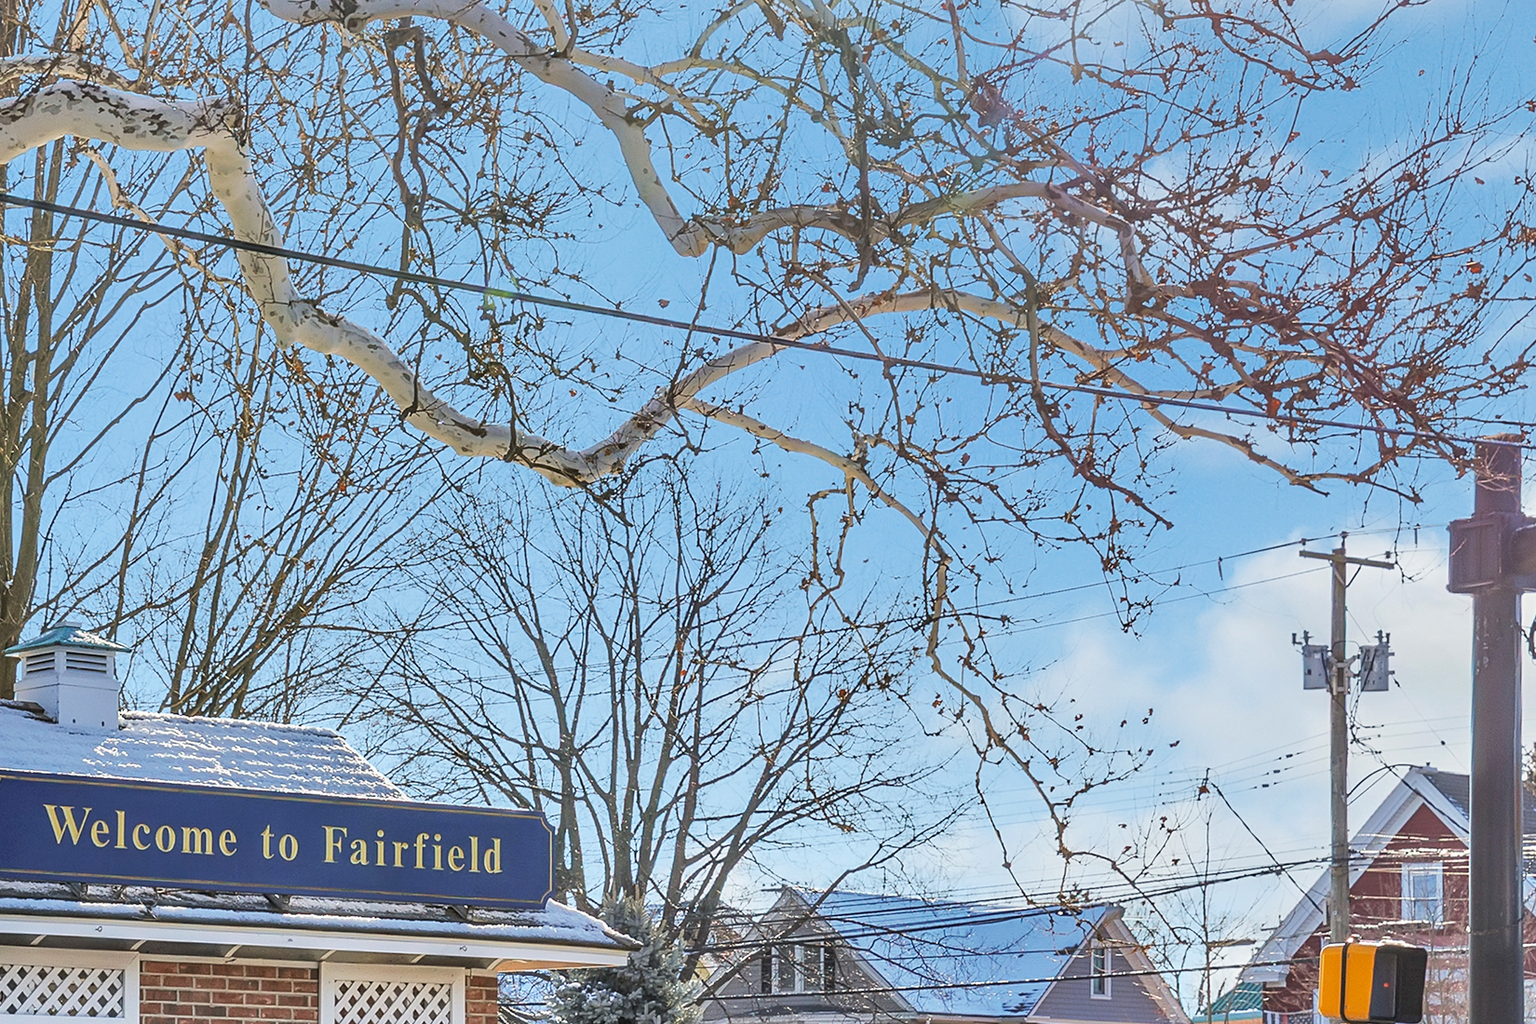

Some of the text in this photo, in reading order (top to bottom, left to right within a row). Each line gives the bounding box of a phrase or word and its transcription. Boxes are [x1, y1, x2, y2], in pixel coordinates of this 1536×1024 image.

[42, 803, 504, 875] Welcome to Fairfield
